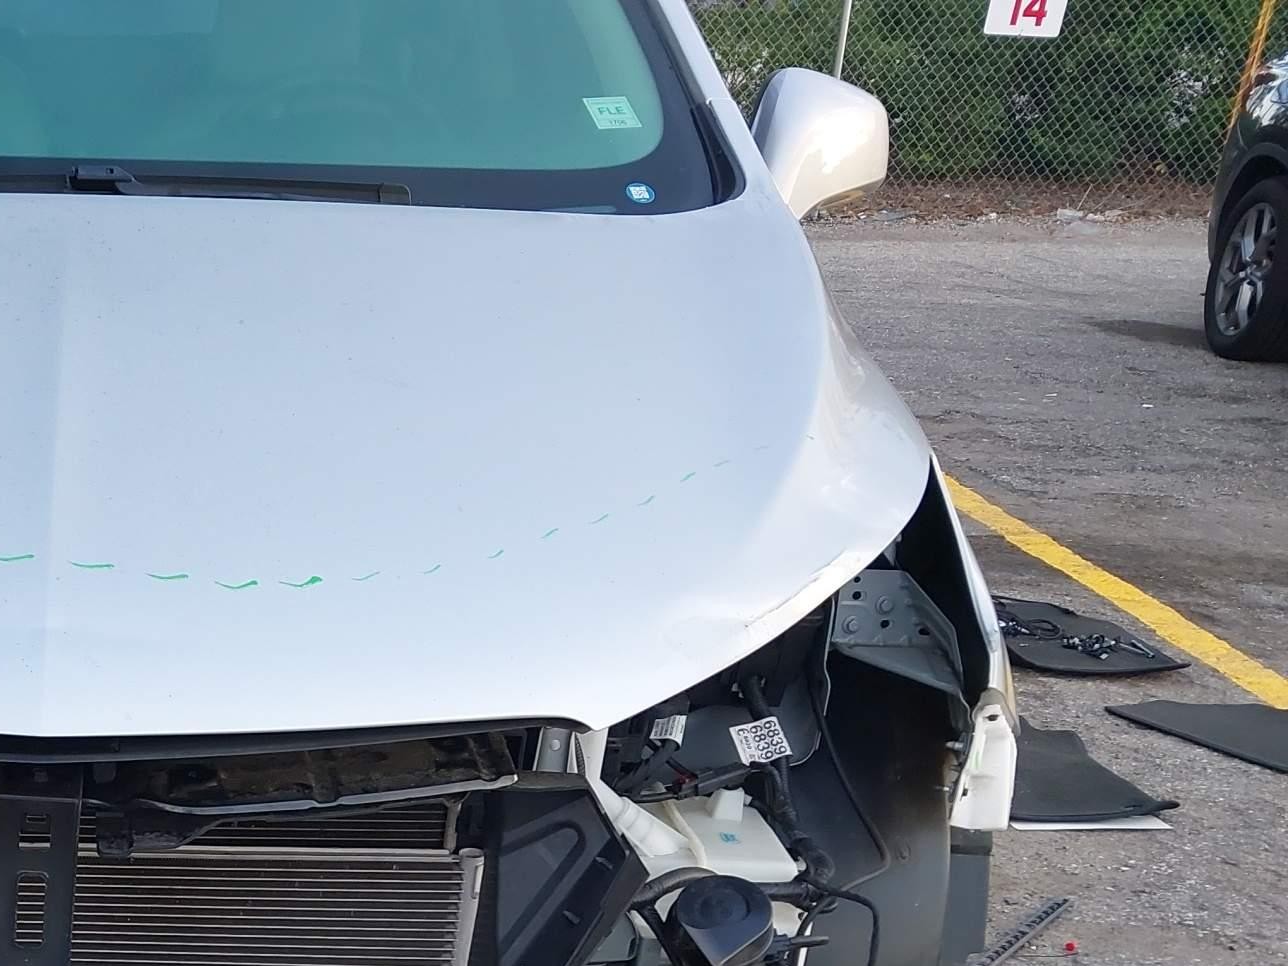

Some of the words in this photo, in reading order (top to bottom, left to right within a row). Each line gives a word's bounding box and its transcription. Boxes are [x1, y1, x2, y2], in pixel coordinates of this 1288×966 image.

[1009, 0, 1048, 26] 14
[598, 105, 627, 115] FLE
[749, 724, 774, 760] 6839
[763, 720, 787, 755] 6839
